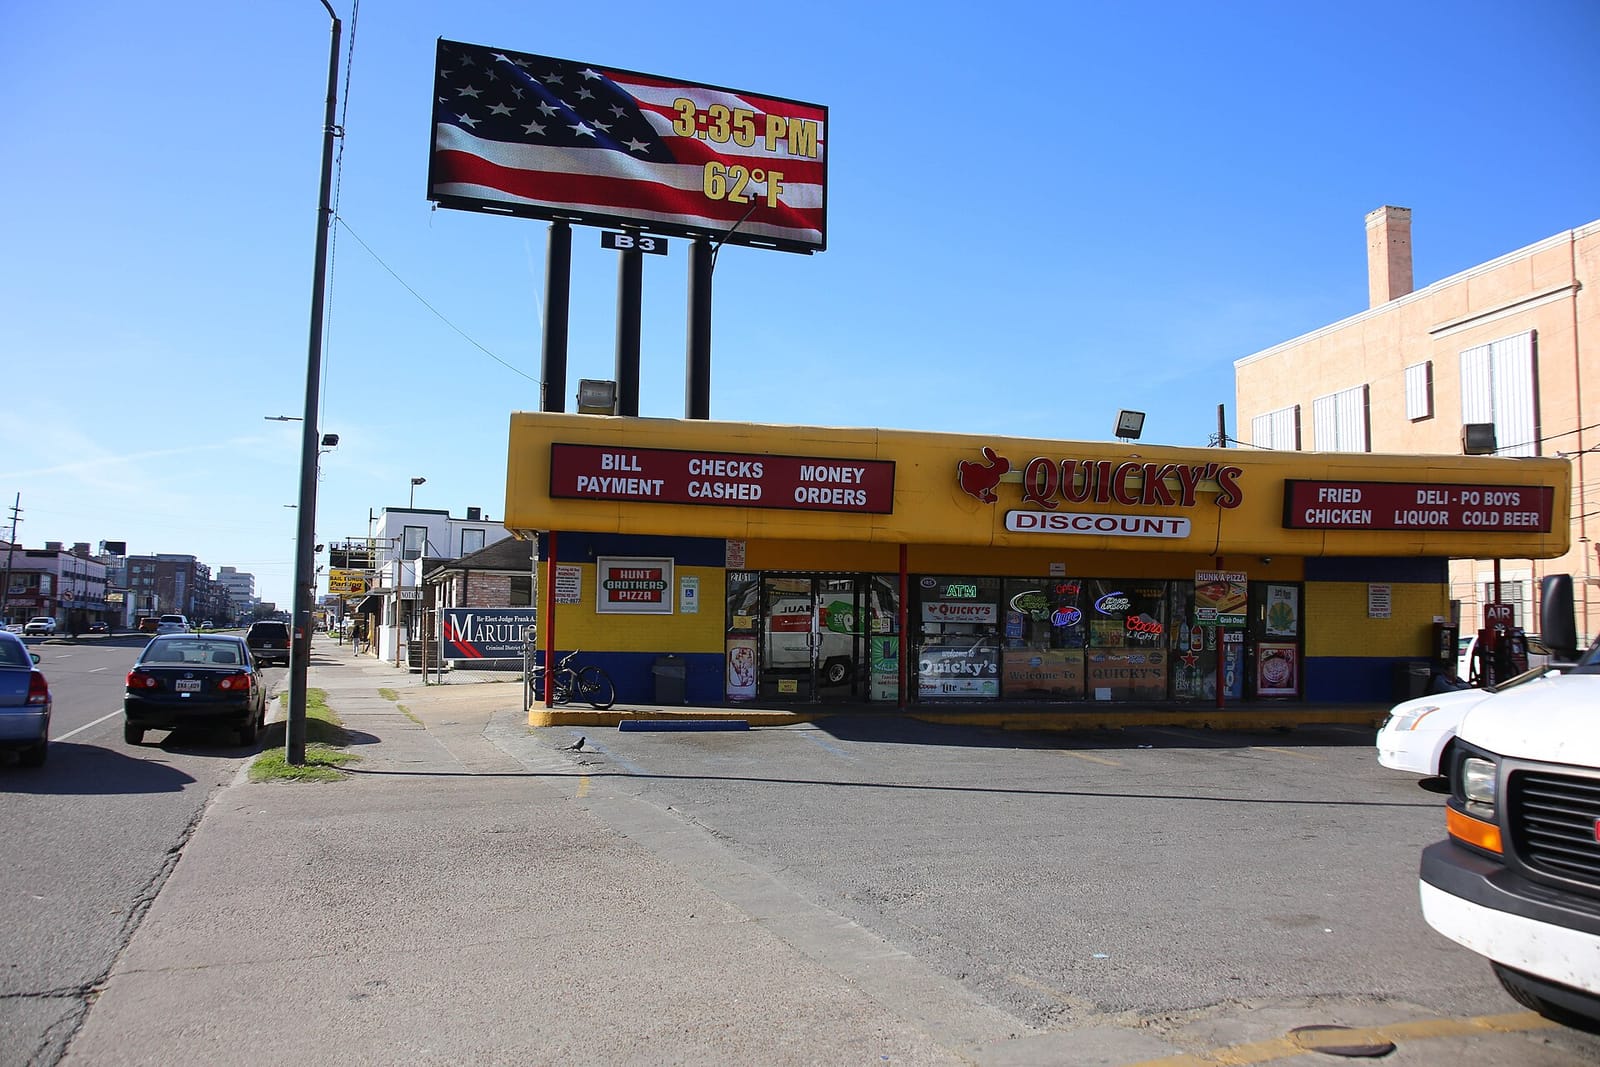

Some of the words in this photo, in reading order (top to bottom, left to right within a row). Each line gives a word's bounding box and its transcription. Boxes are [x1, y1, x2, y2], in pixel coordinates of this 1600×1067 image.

[672, 98, 756, 147] 3:35
[765, 114, 818, 158] PM
[703, 161, 784, 208] 62°F
[601, 454, 641, 472] BILL
[688, 459, 763, 478] CHECKS
[800, 465, 865, 484] MONEY
[577, 476, 664, 496] PAYMENT
[688, 482, 762, 500] CASHED
[1023, 457, 1243, 509] QUICKY'S
[794, 486, 867, 506] ORDERS
[1318, 488, 1362, 503] FRIED
[1417, 490, 1448, 505] DELI
[1461, 492, 1480, 506] PO
[1484, 492, 1520, 506] BOYS
[1015, 514, 1185, 534] DISCOUNT
[1305, 509, 1372, 524] CHICKEN
[1394, 510, 1449, 525] LIQUOR
[1462, 511, 1499, 526] COLD
[1503, 512, 1539, 526] BEER
[620, 570, 651, 579] HUNT
[607, 581, 664, 589] BROTHERS
[946, 584, 976, 597] ATM
[619, 592, 652, 600] PIZZA
[939, 604, 990, 615] QUICKY'S
[1488, 608, 1510, 618] AIR
[1126, 616, 1162, 634] Coors
[1126, 631, 1160, 640] LIGHT
[919, 660, 997, 676] Quicky's
[1093, 668, 1161, 679] QUICKY'S
